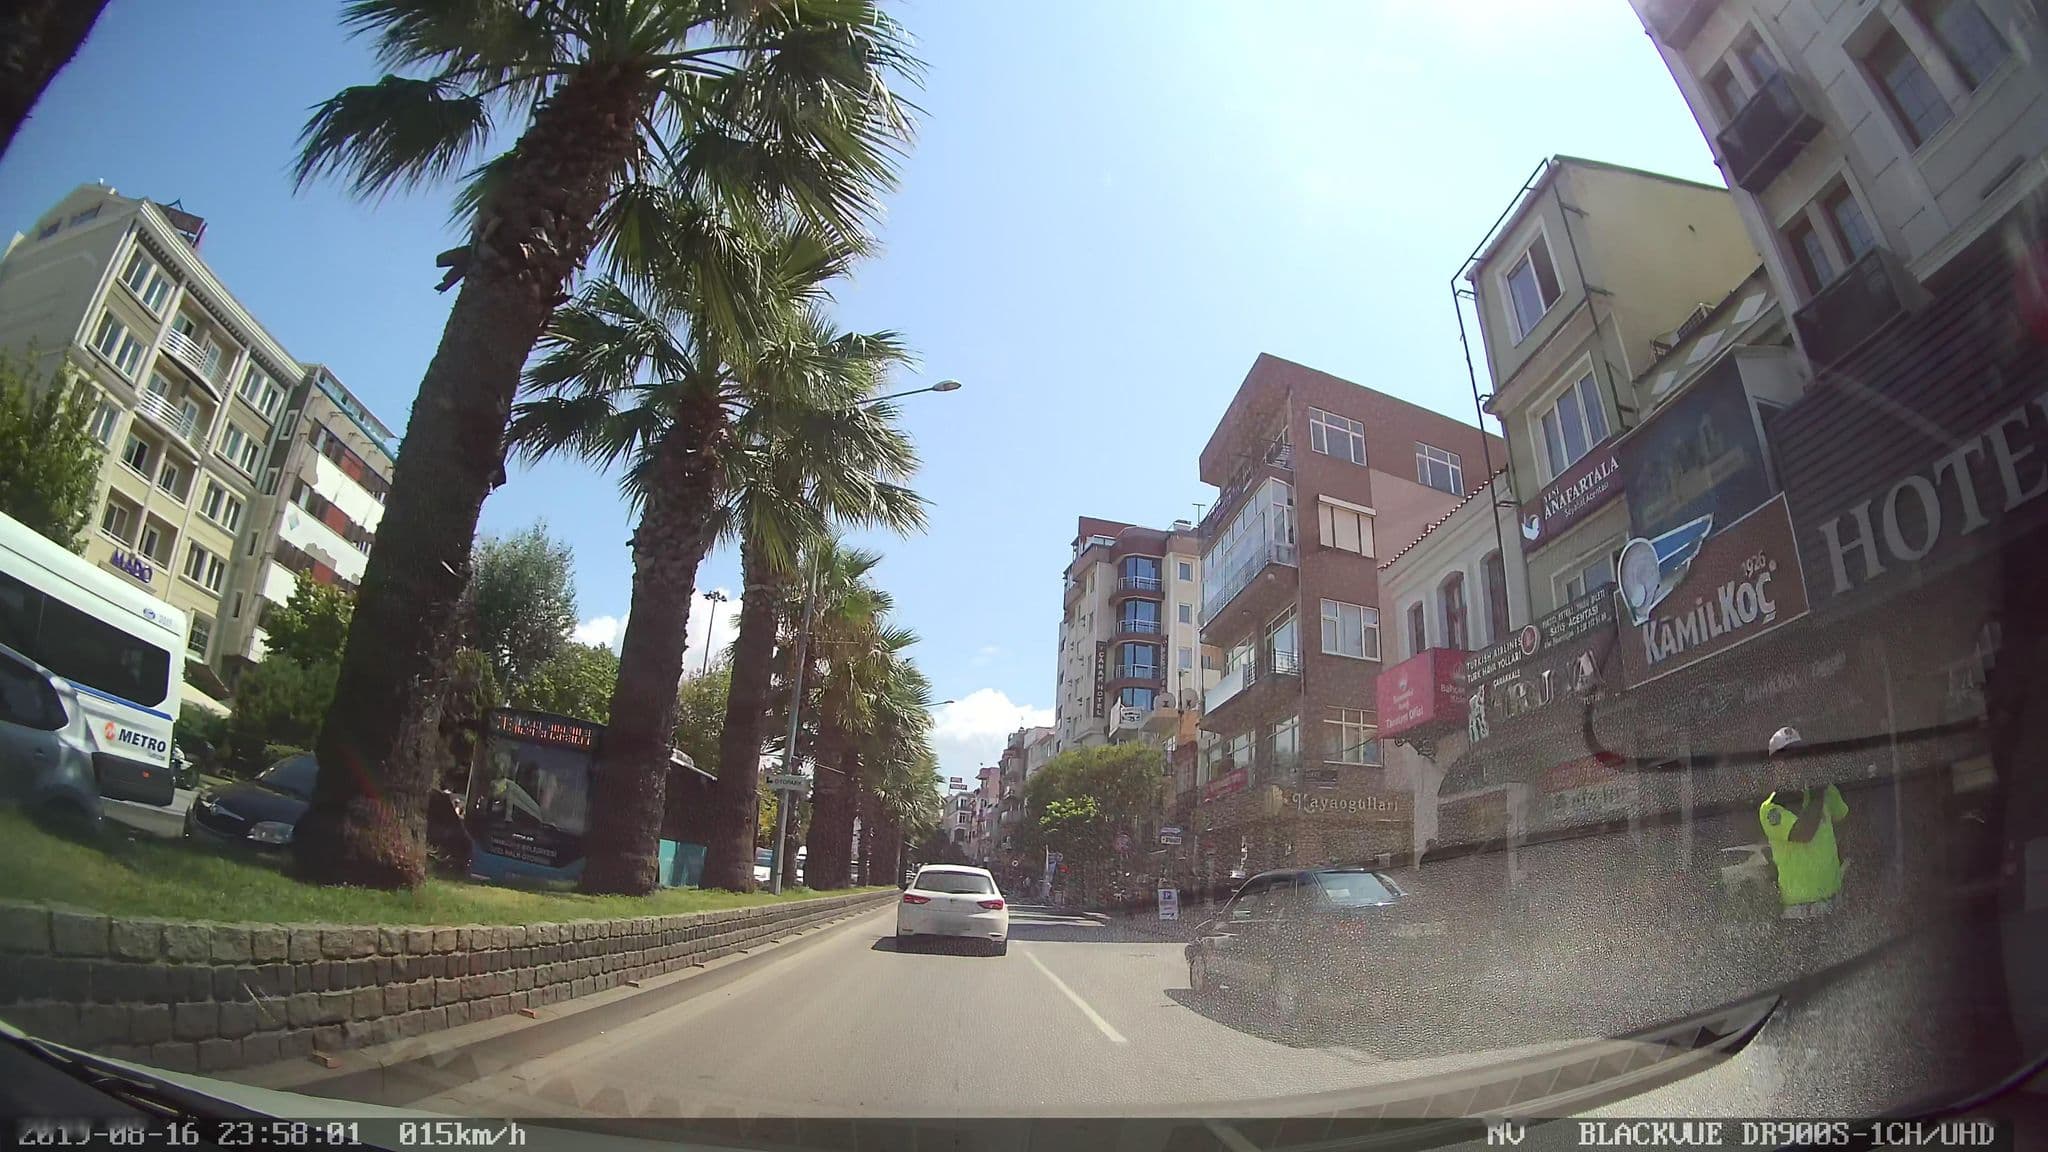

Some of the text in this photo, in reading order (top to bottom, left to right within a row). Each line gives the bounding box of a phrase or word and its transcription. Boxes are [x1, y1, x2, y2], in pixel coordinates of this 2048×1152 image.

[111, 547, 153, 583] MADO
[1742, 550, 1766, 578] 1926
[119, 728, 166, 752] METRO
